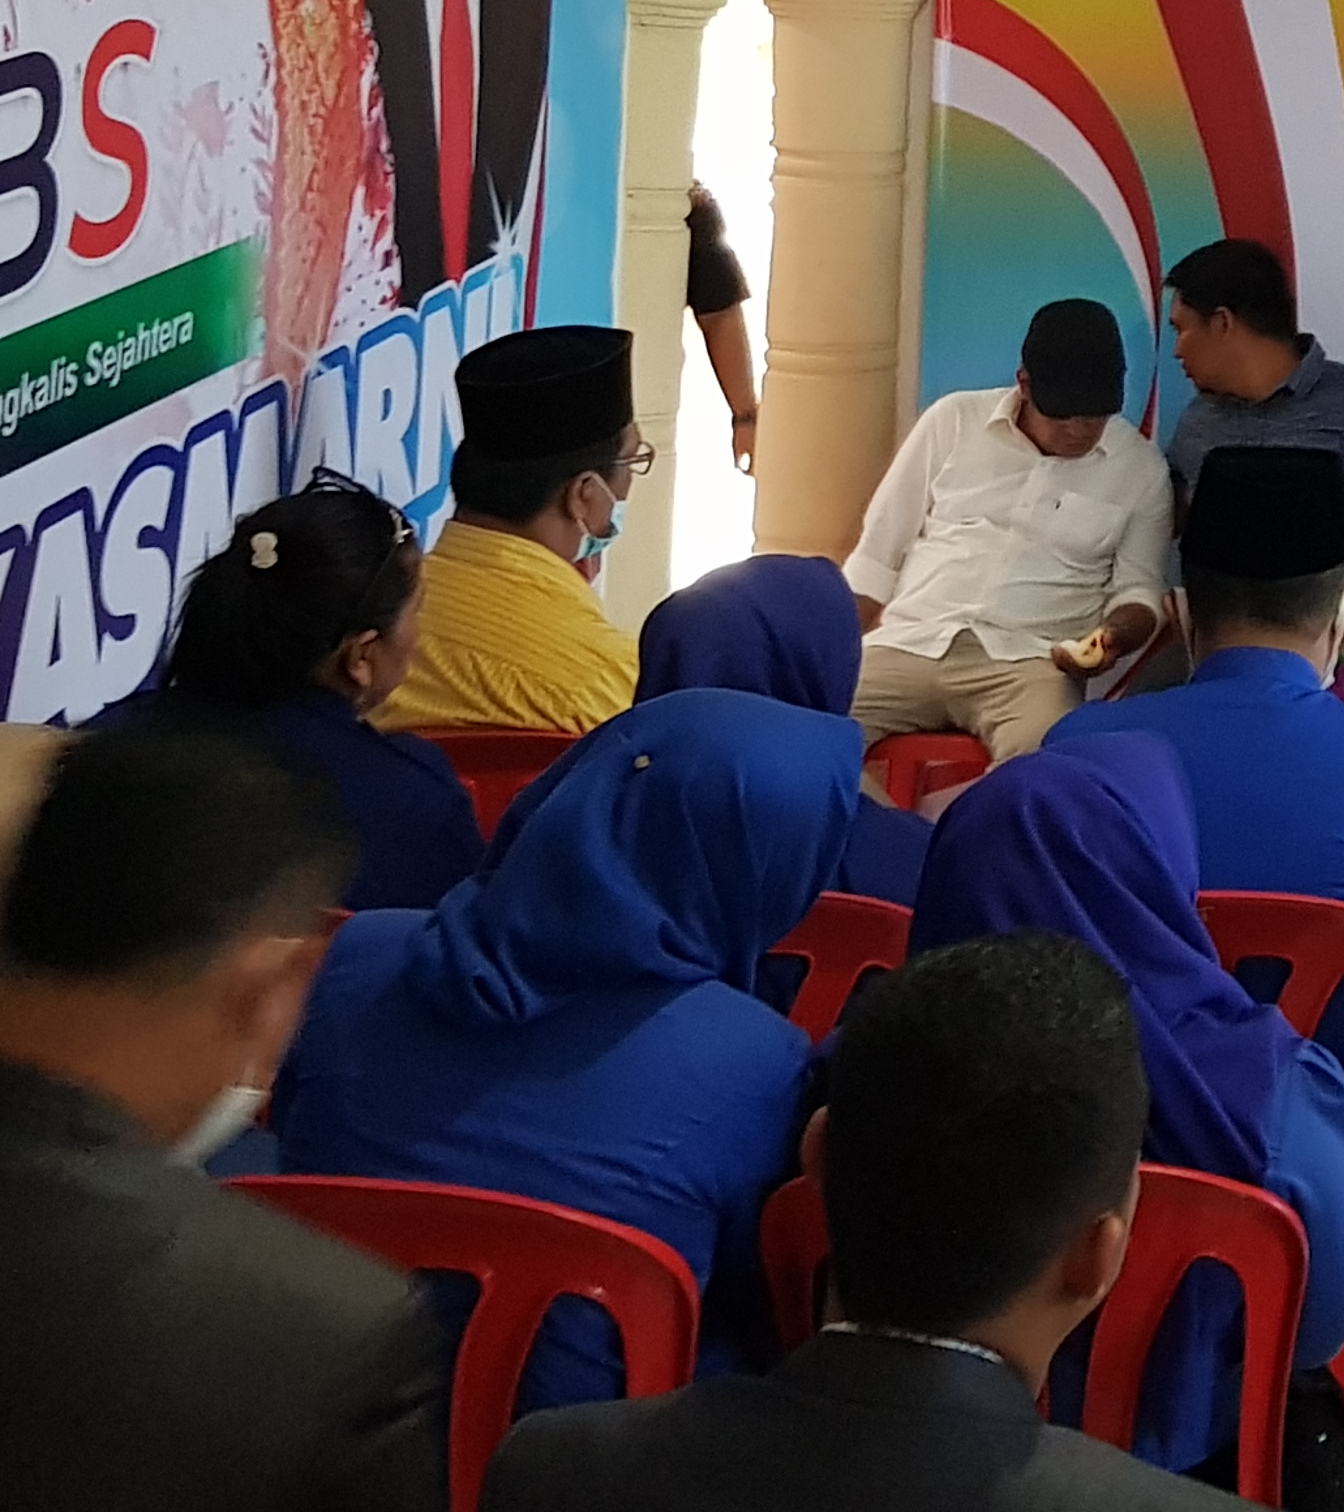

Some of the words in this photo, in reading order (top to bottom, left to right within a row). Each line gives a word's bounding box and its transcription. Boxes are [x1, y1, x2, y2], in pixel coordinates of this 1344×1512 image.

[0, 18, 157, 299] BS
[0, 355, 79, 437] gkalis
[83, 310, 195, 388] Sejahtera
